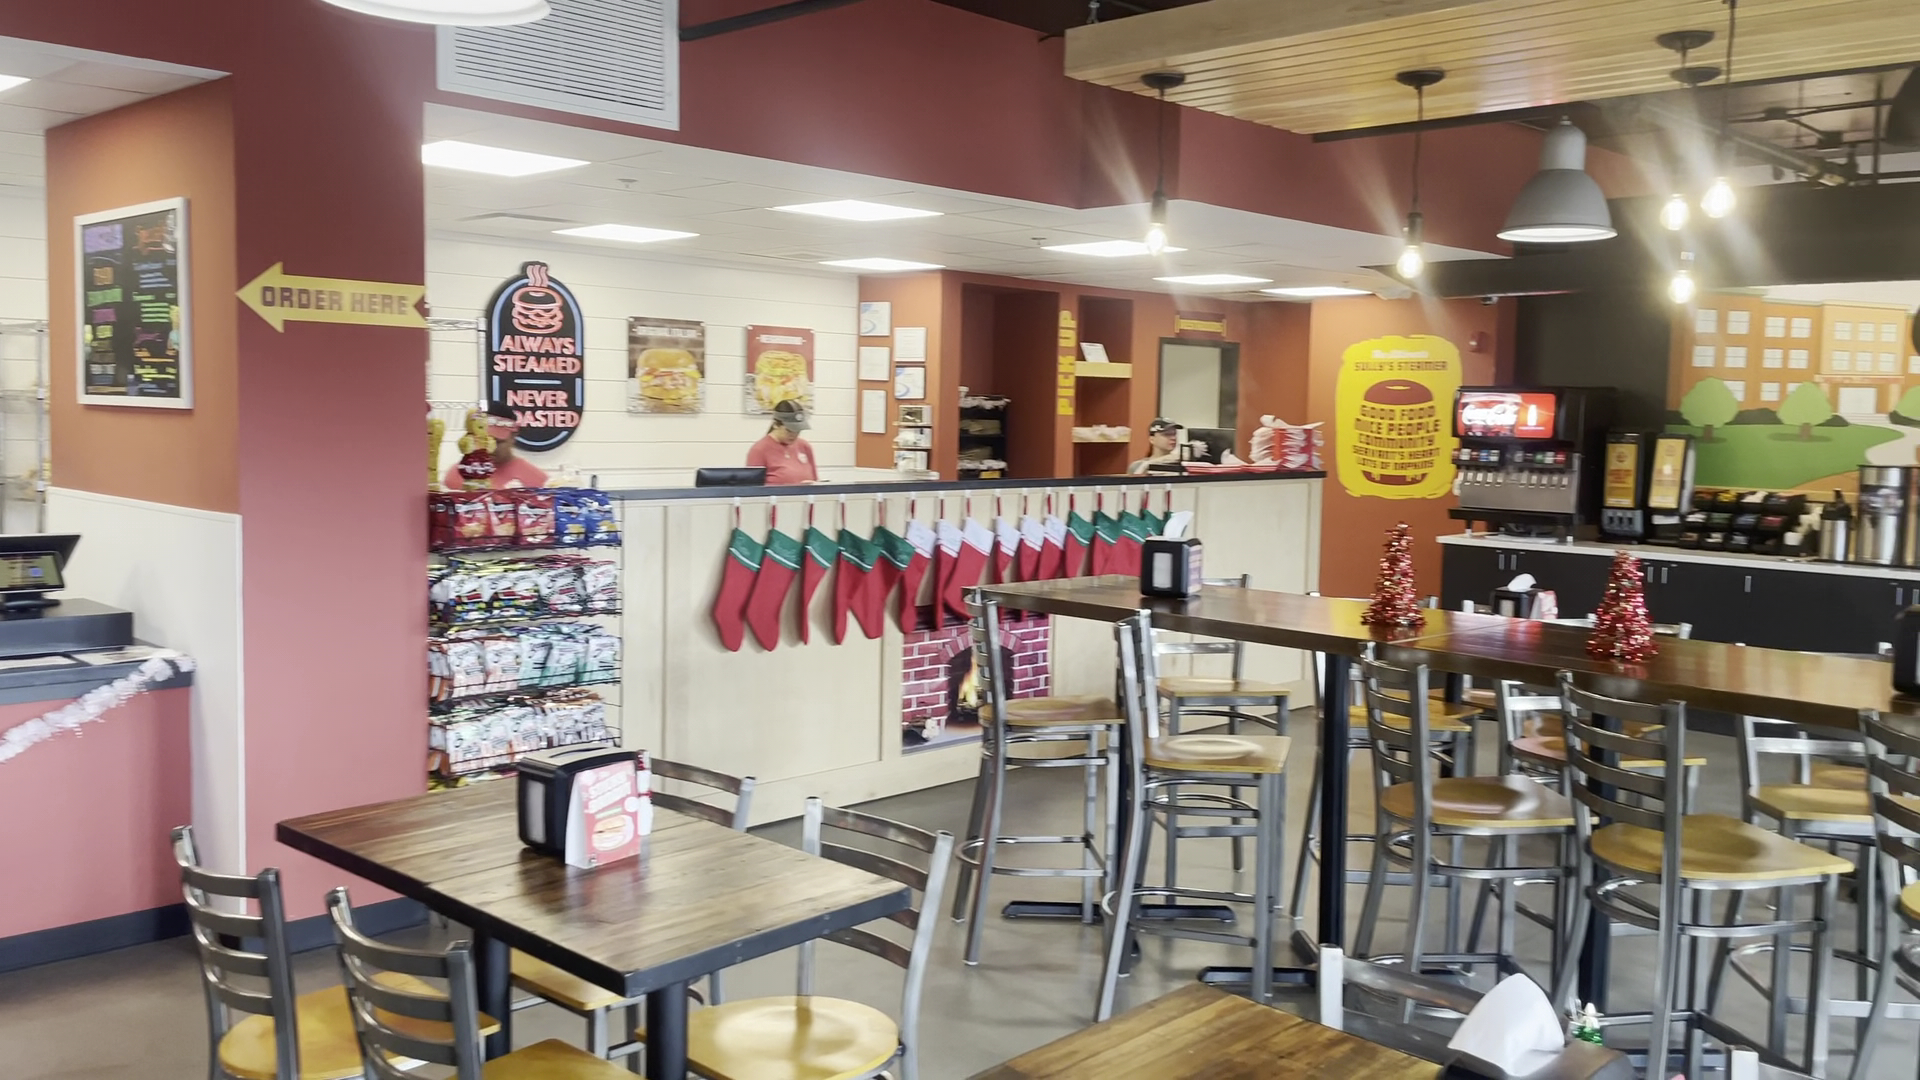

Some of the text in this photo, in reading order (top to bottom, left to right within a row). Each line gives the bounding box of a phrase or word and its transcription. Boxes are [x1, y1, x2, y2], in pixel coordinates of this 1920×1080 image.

[262, 286, 409, 315] ORDER HERE
[500, 335, 575, 354] ALWAYS
[493, 354, 581, 374] STEAMED
[1058, 311, 1077, 415] PICK UP
[507, 389, 568, 408] NEVER
[512, 410, 580, 428] OASTED
[1360, 405, 1435, 420] GOOD FOOD
[1355, 418, 1440, 436] NICE PEOPLE
